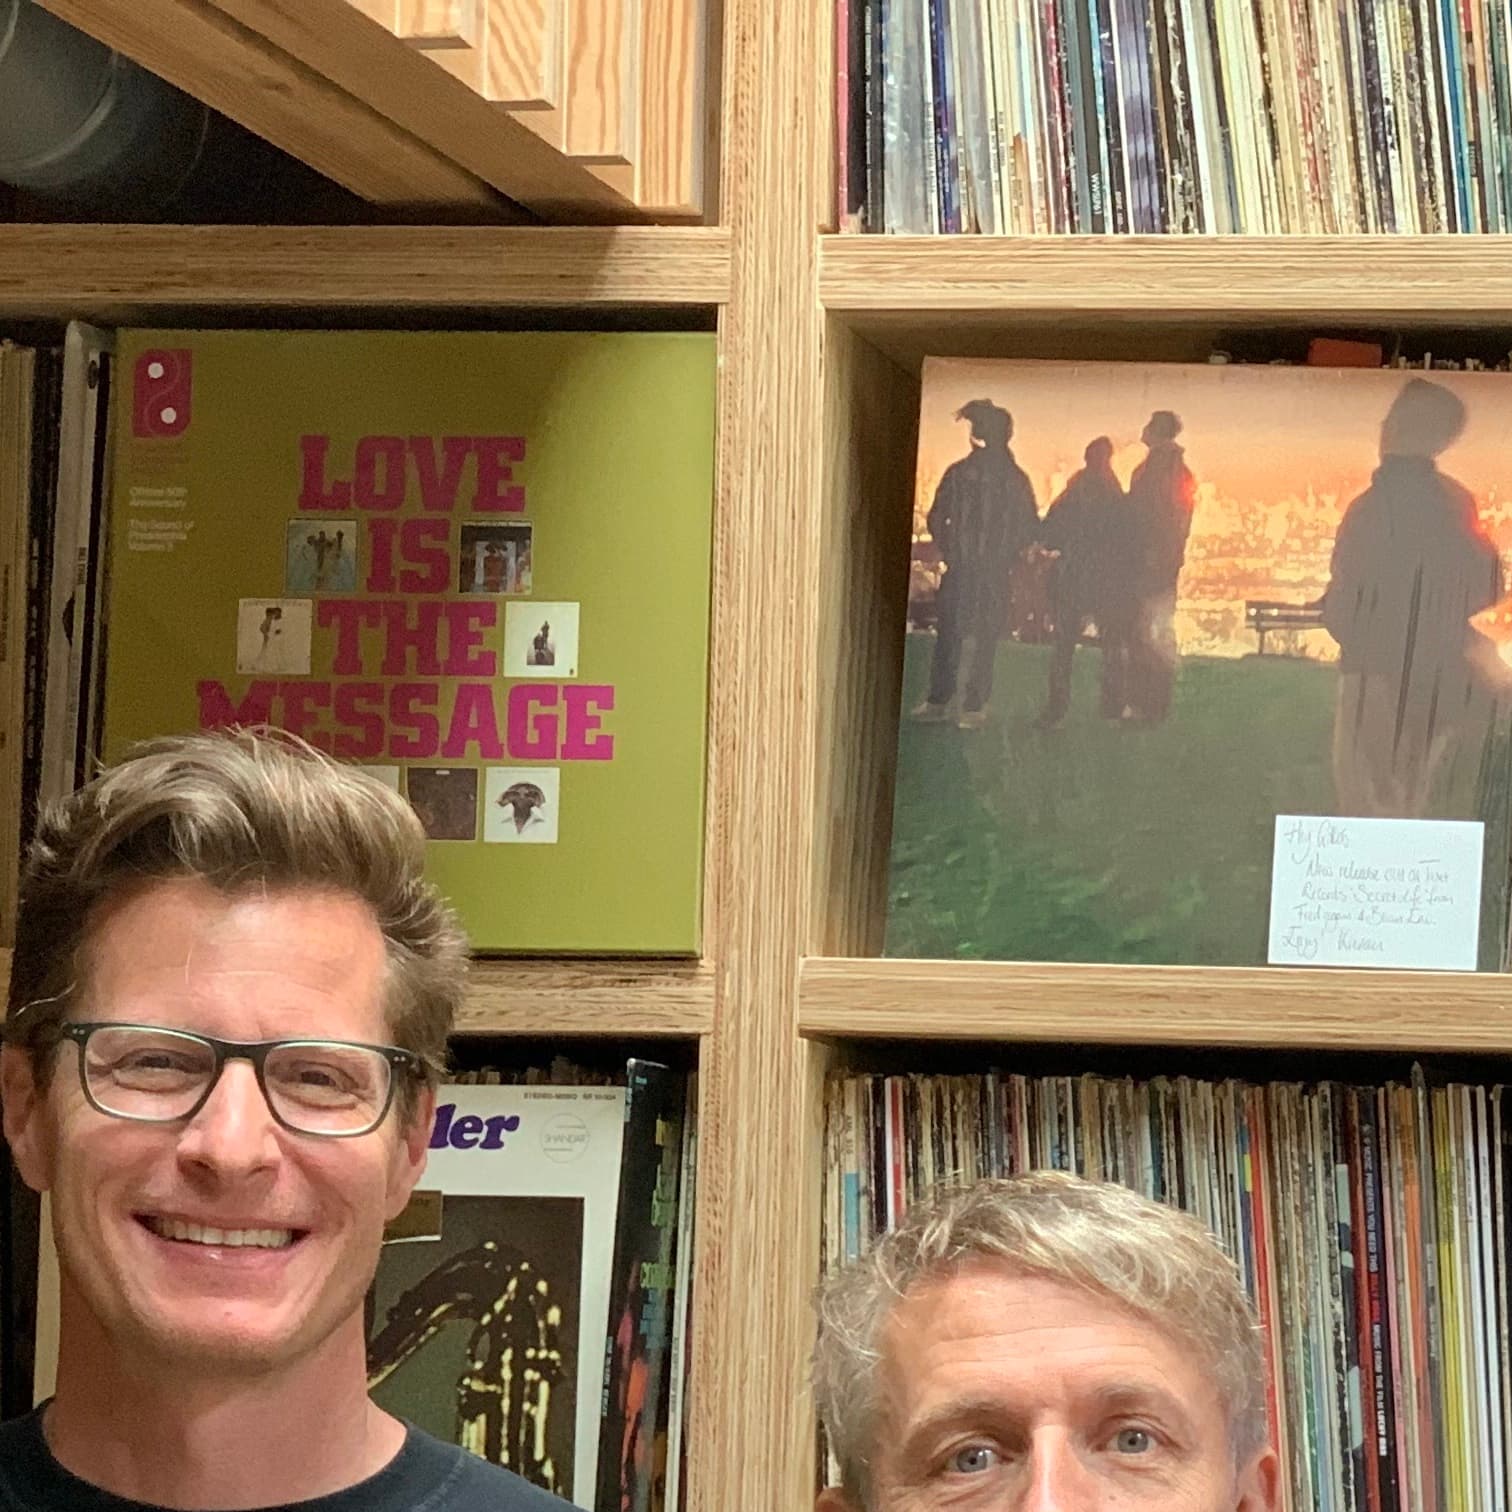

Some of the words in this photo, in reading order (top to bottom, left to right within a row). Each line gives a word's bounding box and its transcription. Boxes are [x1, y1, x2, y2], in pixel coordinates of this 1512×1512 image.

[297, 436, 526, 513] LOVE
[366, 518, 450, 594] IS
[315, 601, 497, 676] THE
[197, 681, 614, 760] MESSAGE
[429, 1103, 520, 1149] ler
[1366, 1213, 1375, 1230] YOU
[1367, 1230, 1377, 1252] NEED
[1368, 1253, 1378, 1272] THIS
[1374, 1349, 1382, 1373] FROM
[1375, 1374, 1383, 1389] THE
